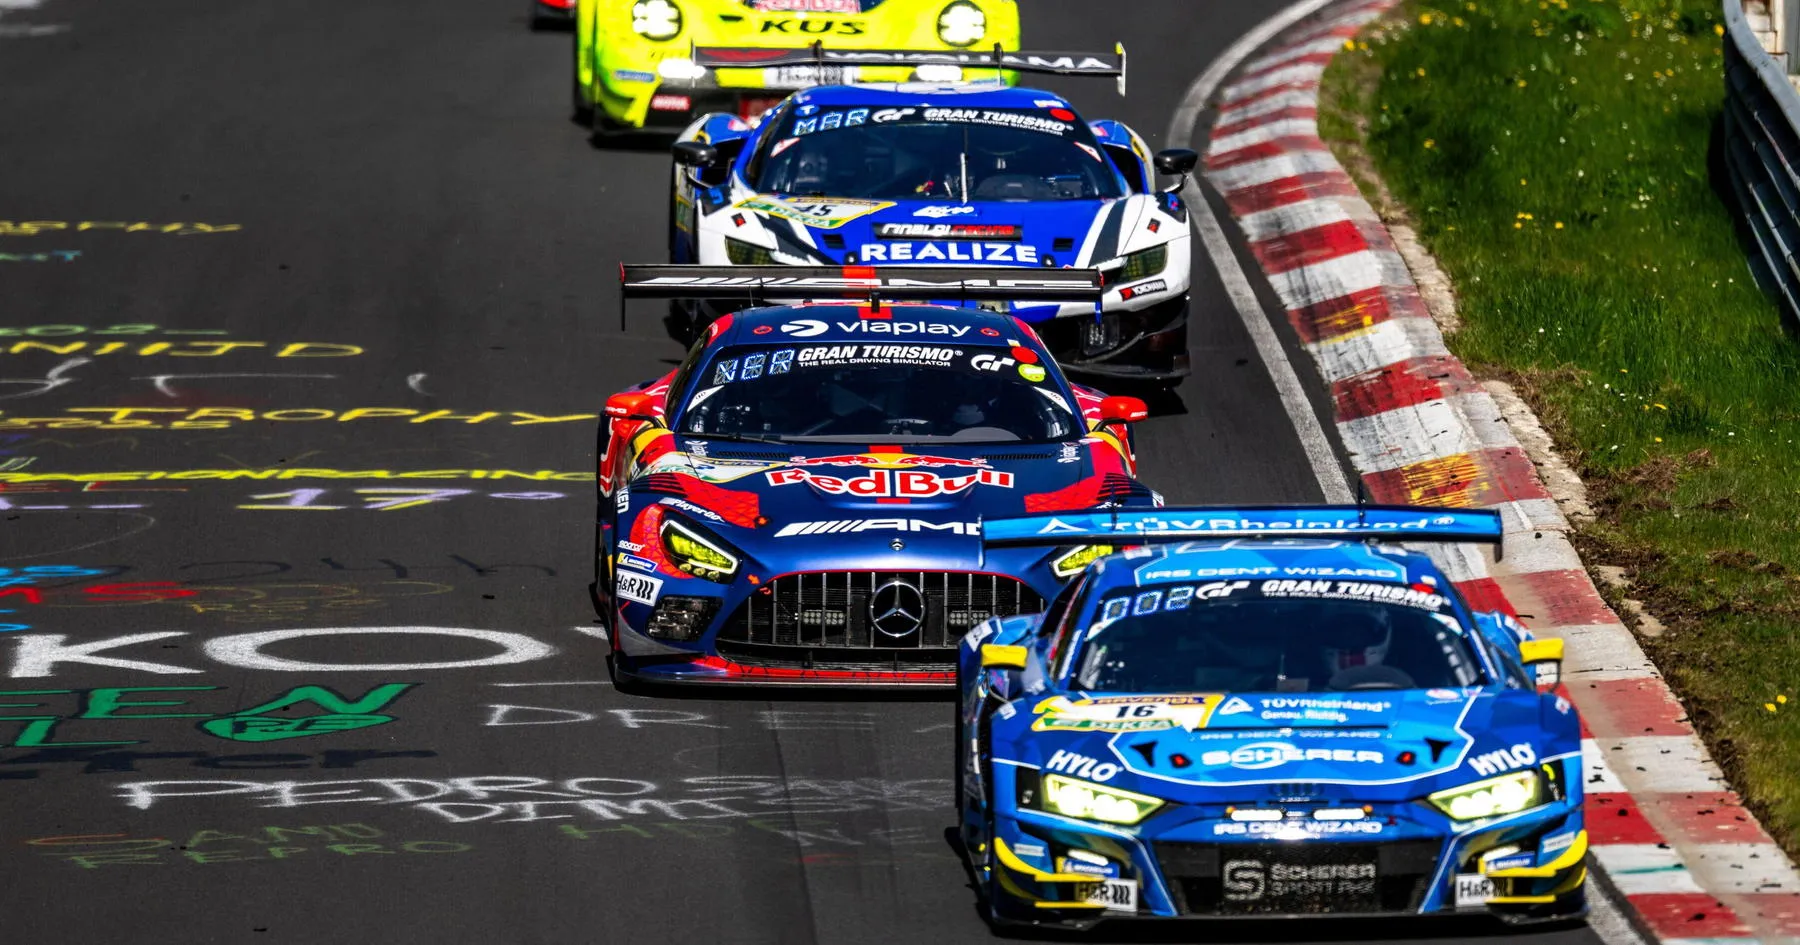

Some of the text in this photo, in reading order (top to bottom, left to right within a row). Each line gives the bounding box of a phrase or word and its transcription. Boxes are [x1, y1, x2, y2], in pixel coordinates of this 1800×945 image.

[760, 20, 865, 33] KUS
[924, 108, 974, 120] GRAN
[793, 108, 869, 136] MAR
[861, 243, 1038, 263] REALIZE
[836, 320, 971, 337] viaplay
[798, 346, 858, 361] GRAN
[893, 357, 951, 367] SIMULATOR
[66, 406, 600, 426] TROPHY
[764, 468, 1015, 498] Red Bull
[1145, 566, 1398, 579] IRS DENT WIZARD
[1261, 579, 1331, 593] GRAN
[8, 626, 612, 679] KO
[1115, 705, 1158, 718] 16
[1202, 749, 1384, 765] SCHERER
[112, 778, 655, 809] PEDRO
[1213, 823, 1247, 835] IRS
[1304, 821, 1382, 834] WIZARD
